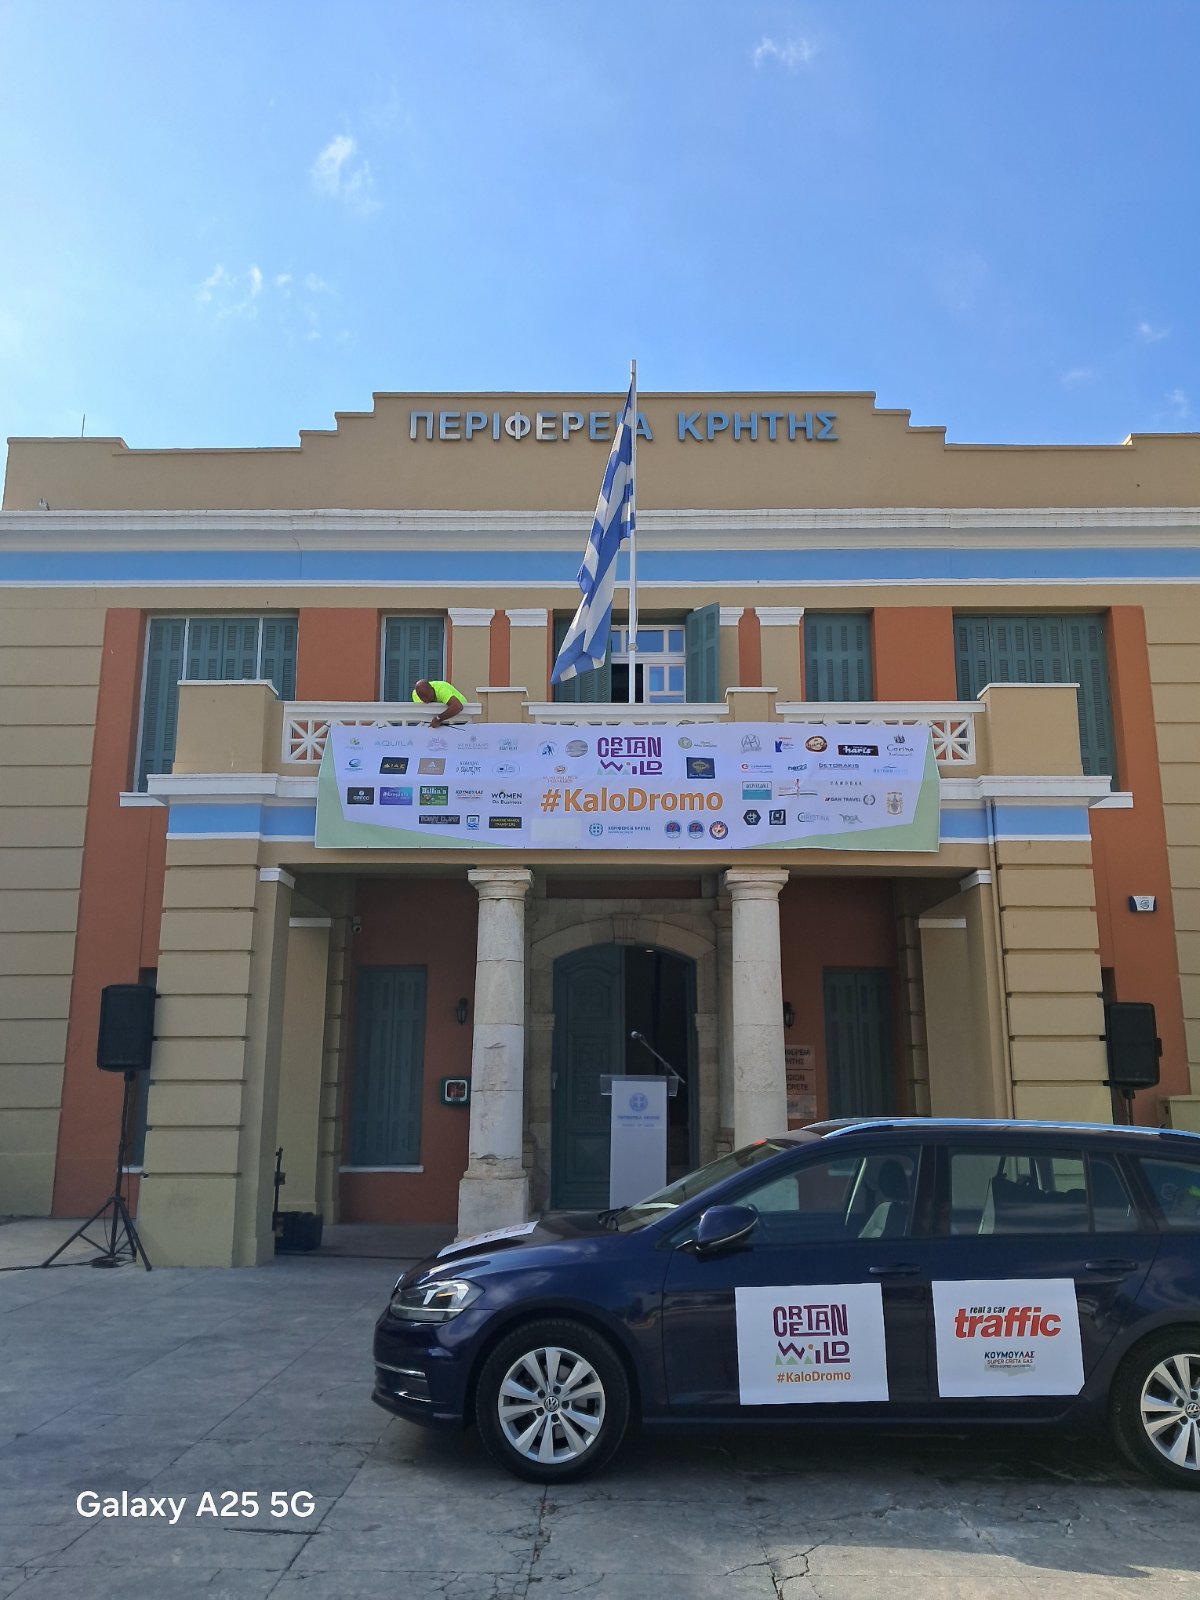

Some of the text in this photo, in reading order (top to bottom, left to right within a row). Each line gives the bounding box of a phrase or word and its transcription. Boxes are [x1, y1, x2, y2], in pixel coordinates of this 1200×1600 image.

[678, 411, 839, 441] ΚΡΗΤΗΣ
[491, 791, 523, 799] WOMEN
[540, 787, 723, 812] #KaloDromo
[969, 1305, 986, 1314] rent
[993, 1306, 1006, 1314] car
[955, 1306, 1061, 1338] traffic
[984, 1350, 1035, 1359] ΚΟΥΜΟΥΛΑΣ
[776, 1371, 851, 1383] #KaloDromo
